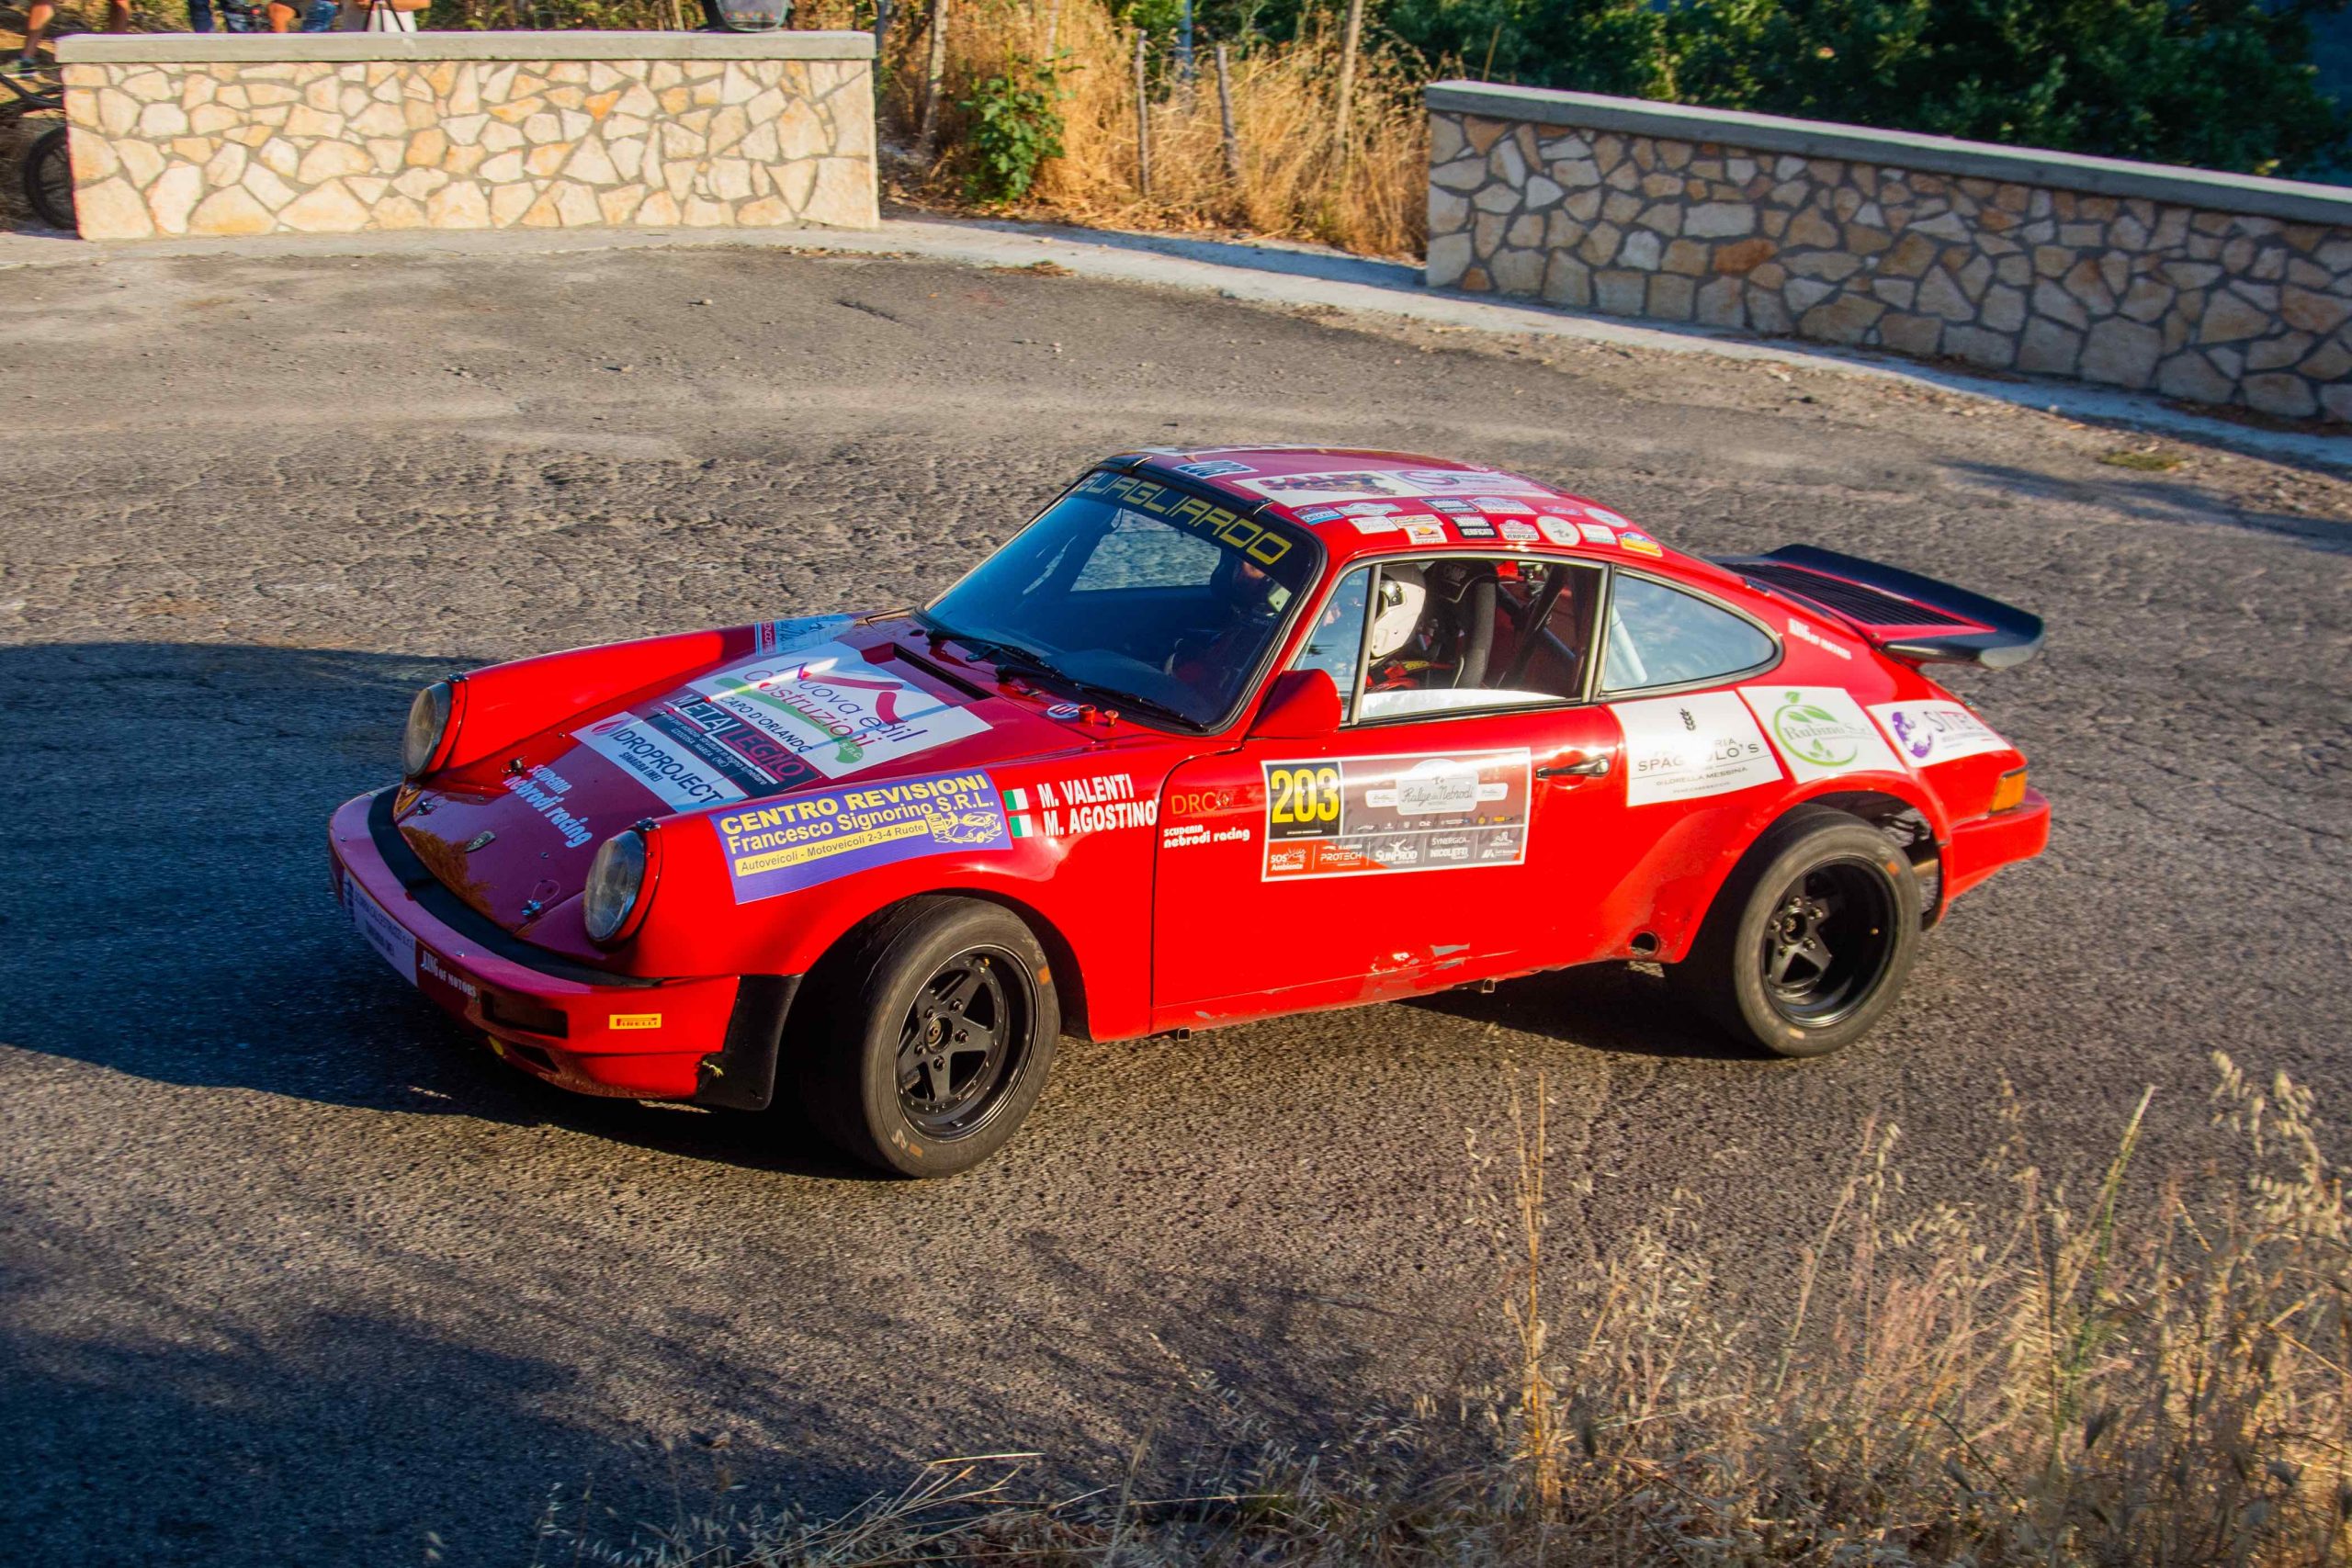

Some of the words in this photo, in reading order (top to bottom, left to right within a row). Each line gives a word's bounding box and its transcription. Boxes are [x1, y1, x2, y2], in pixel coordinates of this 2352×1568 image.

[720, 696, 753, 714] CAPO
[743, 669, 883, 748] Costruzioni
[609, 727, 725, 804] IDROPROJECT
[1637, 742, 1760, 772] SPAGLO'S
[719, 795, 839, 836] CENTRO
[843, 773, 989, 811] REVISIONI
[1036, 783, 1060, 809] M.
[1059, 773, 1135, 807] VALENTI
[1271, 767, 1340, 824] 203
[544, 805, 594, 849] racing
[728, 822, 834, 855] Francesco
[838, 802, 934, 831] Signorino
[938, 791, 994, 813] S.R.L.
[1042, 809, 1065, 837] M.
[1069, 799, 1158, 834] AGOSTINO
[1163, 829, 1211, 849] nebrodi
[1213, 827, 1250, 843] racing
[741, 852, 799, 873] Autoveicoli
[808, 836, 865, 858] Motoveicoli
[866, 829, 893, 845] 2-3-4
[894, 823, 924, 839] Ruote
[1270, 853, 1288, 863] SOS
